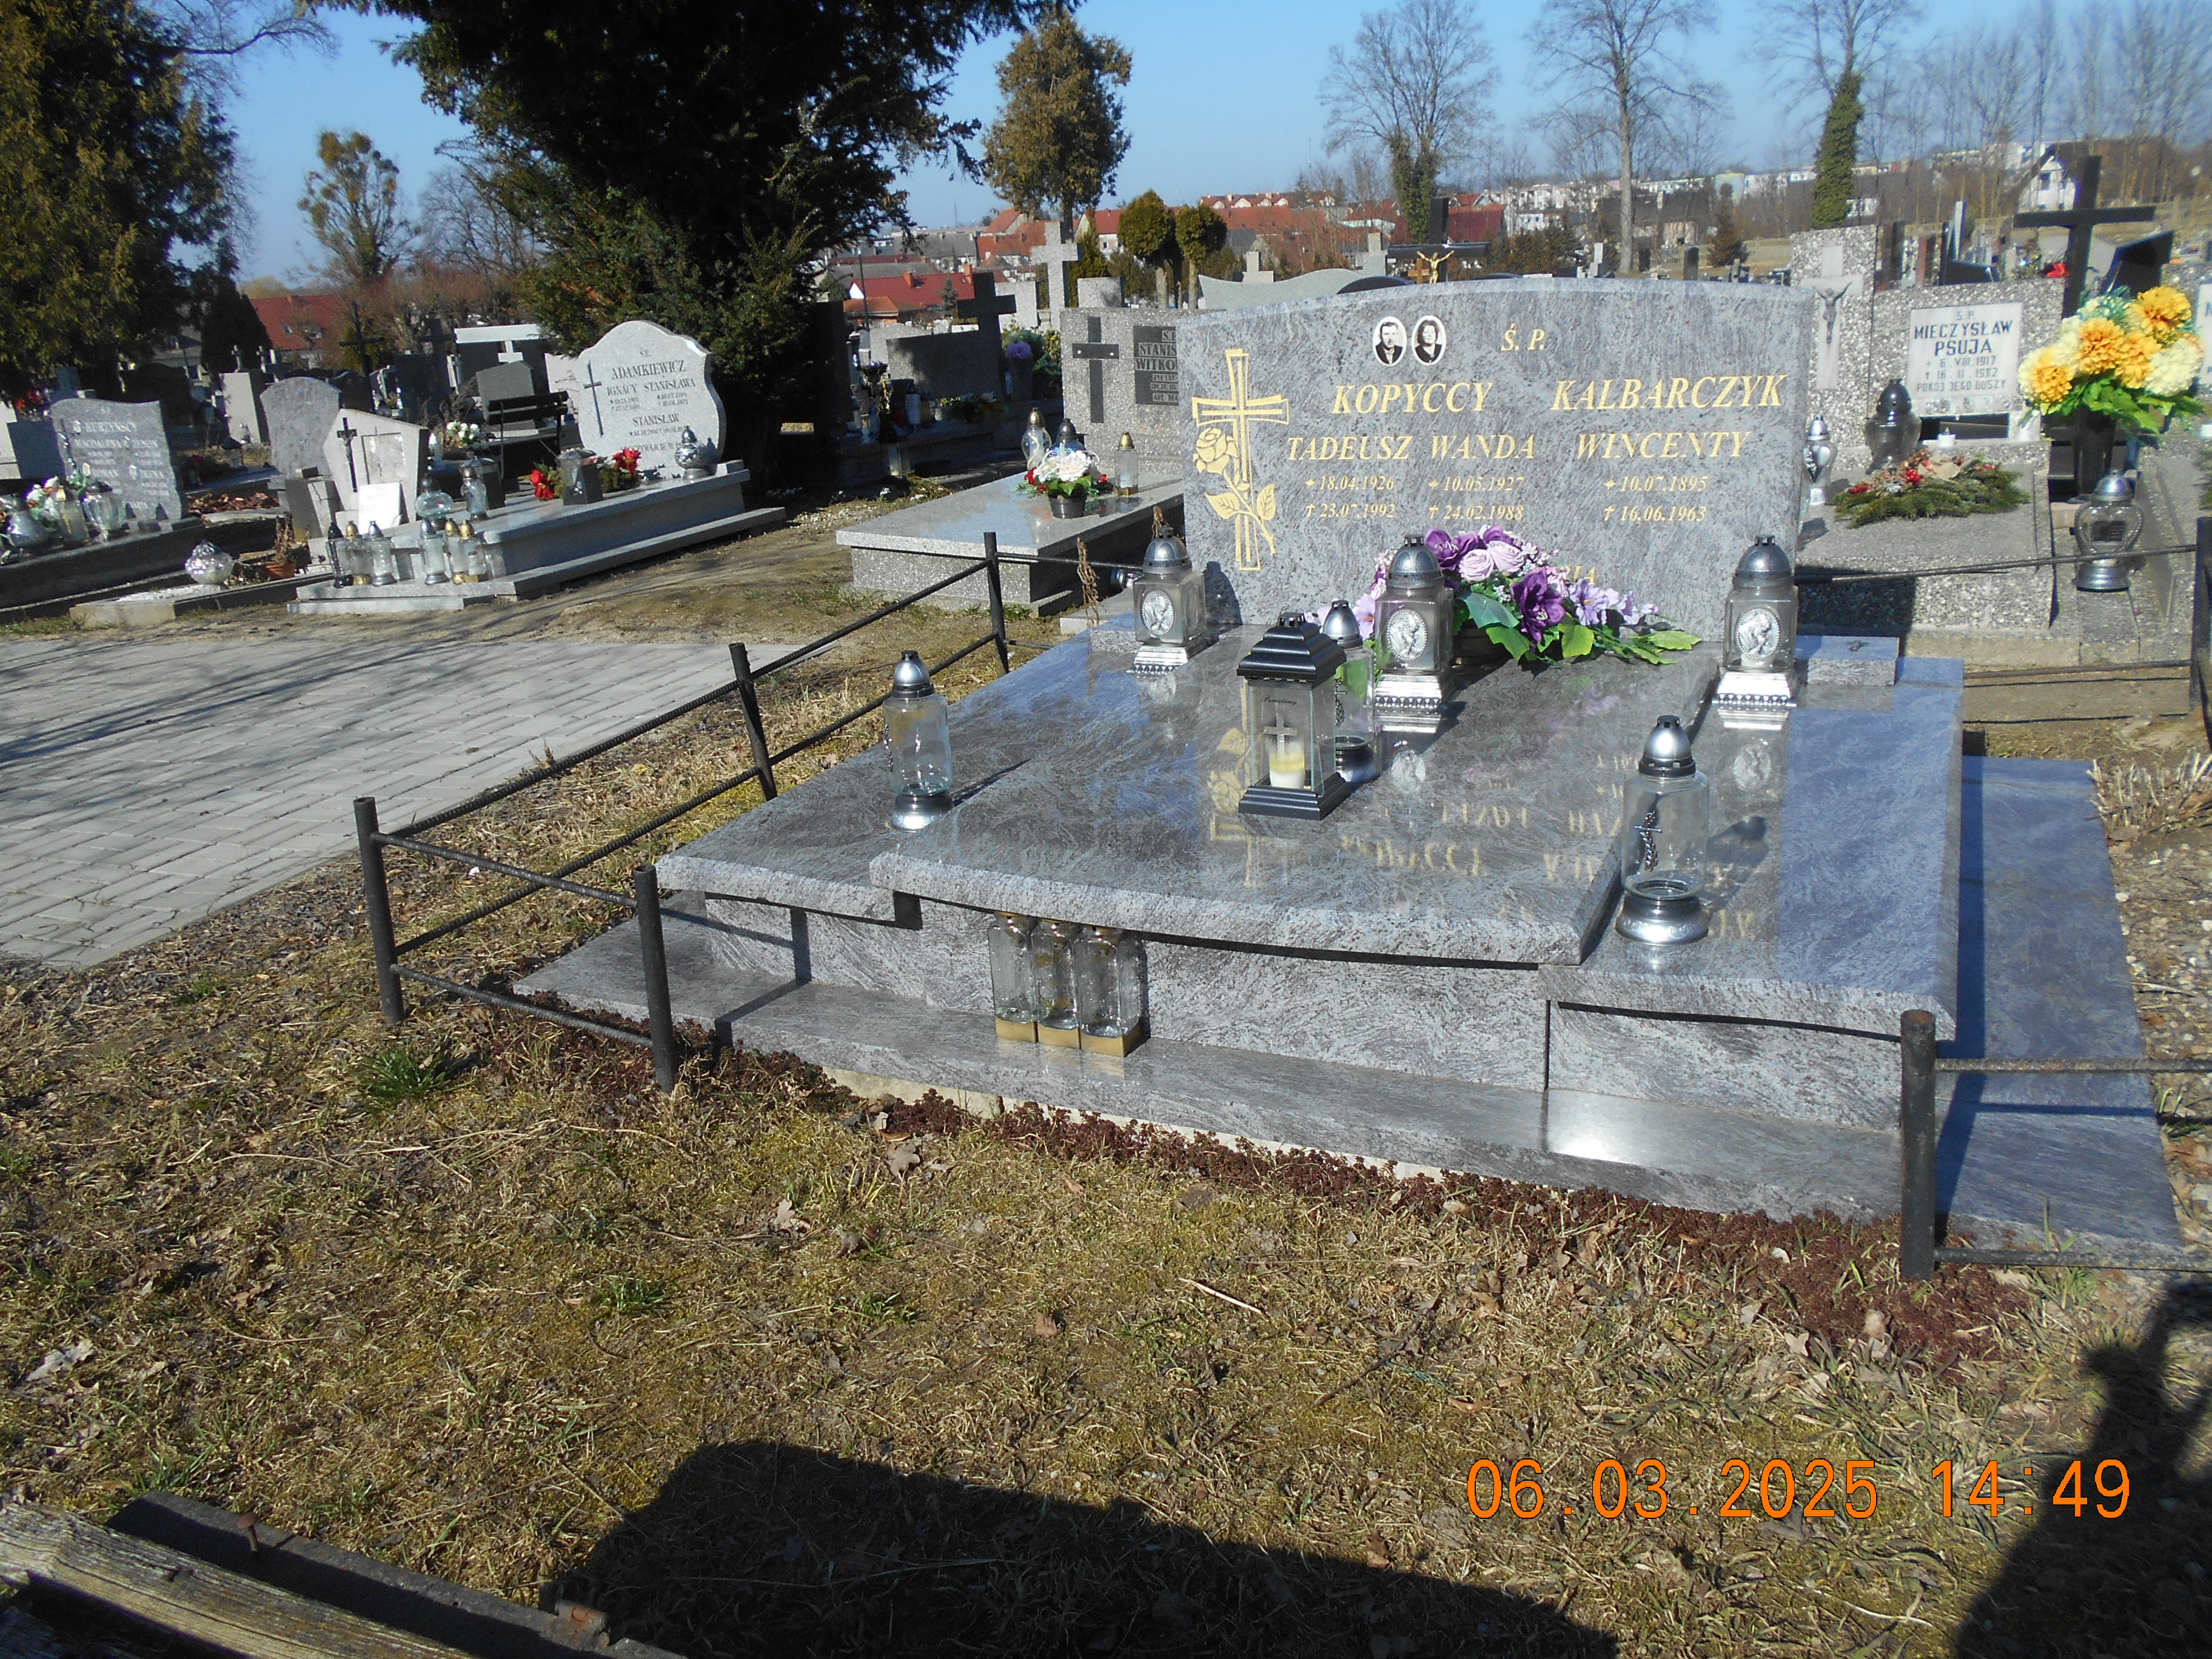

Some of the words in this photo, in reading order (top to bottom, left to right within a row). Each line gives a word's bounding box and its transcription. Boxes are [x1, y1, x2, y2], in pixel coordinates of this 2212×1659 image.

[1501, 323, 1519, 350] Ś.
[1527, 329, 1545, 350] P.
[1914, 320, 2013, 339] MIECZYSŁAW
[1140, 343, 1176, 356] STANIS
[1934, 339, 1992, 356] PSUJA
[612, 360, 686, 380] ADAMKIEWICZ
[1136, 358, 1178, 370] WITKO
[606, 384, 637, 396] IGNACY
[643, 378, 696, 392] STANISŁAWA
[1330, 381, 1494, 414] KOPYCCY
[1551, 374, 1788, 410] KALBARCZYK
[1917, 381, 1945, 392] POKÓJ
[1949, 381, 1971, 391] JEGO
[632, 414, 680, 427] STANISŁAW
[1288, 435, 1413, 460] TADEUSZ
[1431, 434, 1535, 460] WANDA
[1577, 431, 1751, 458] WINCENTY
[1319, 476, 1395, 491] 18.04.1926
[1443, 477, 1525, 491] 10.05.1927
[1620, 475, 1708, 491] 10.07.1895
[1319, 503, 1395, 518] 23.07.1992
[1443, 504, 1524, 520] 24.02.1988
[1620, 505, 1708, 521] 16.06.1963
